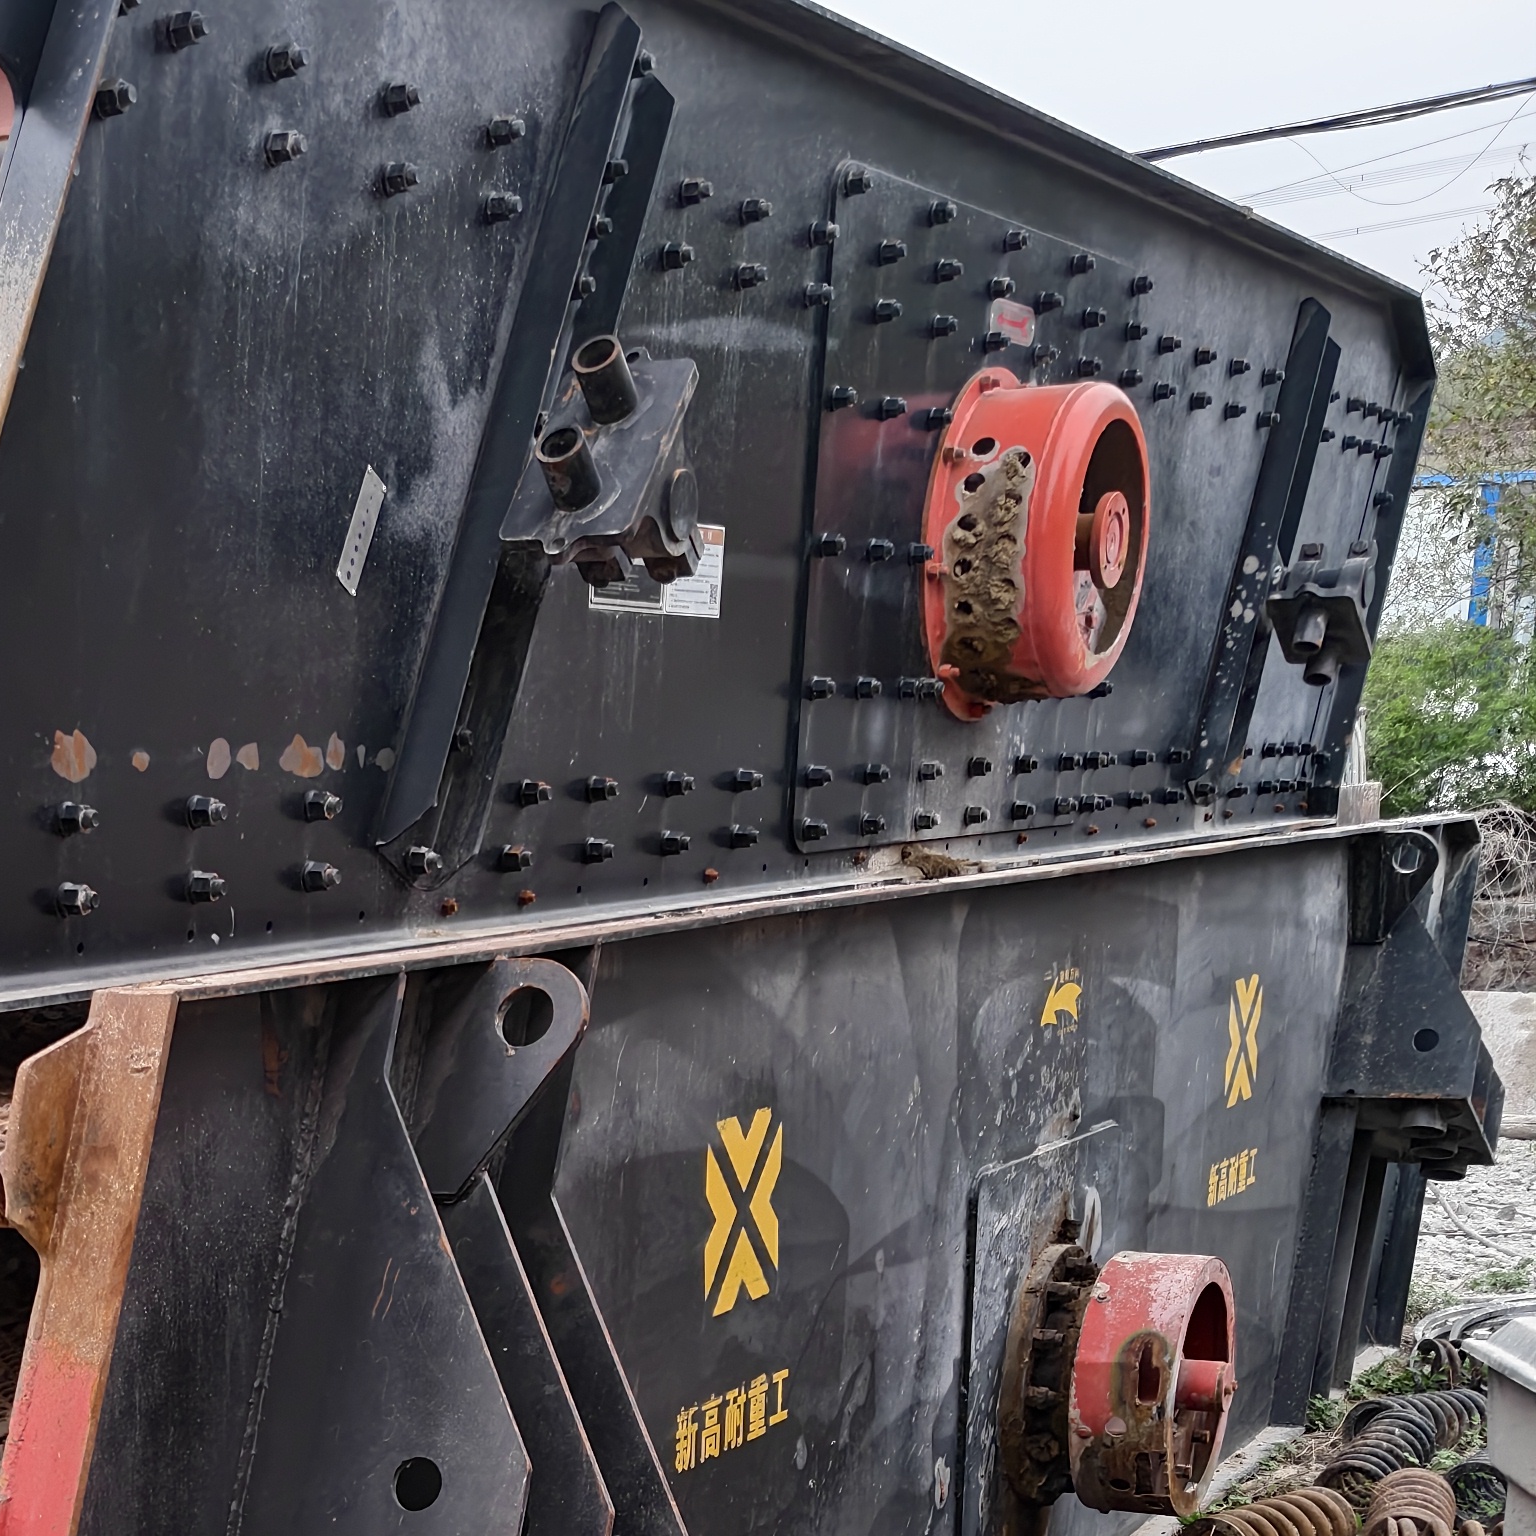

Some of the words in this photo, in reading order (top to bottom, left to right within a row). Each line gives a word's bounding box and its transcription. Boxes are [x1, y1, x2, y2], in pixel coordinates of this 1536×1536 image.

[674, 1368, 789, 1474] 新高耐重工
